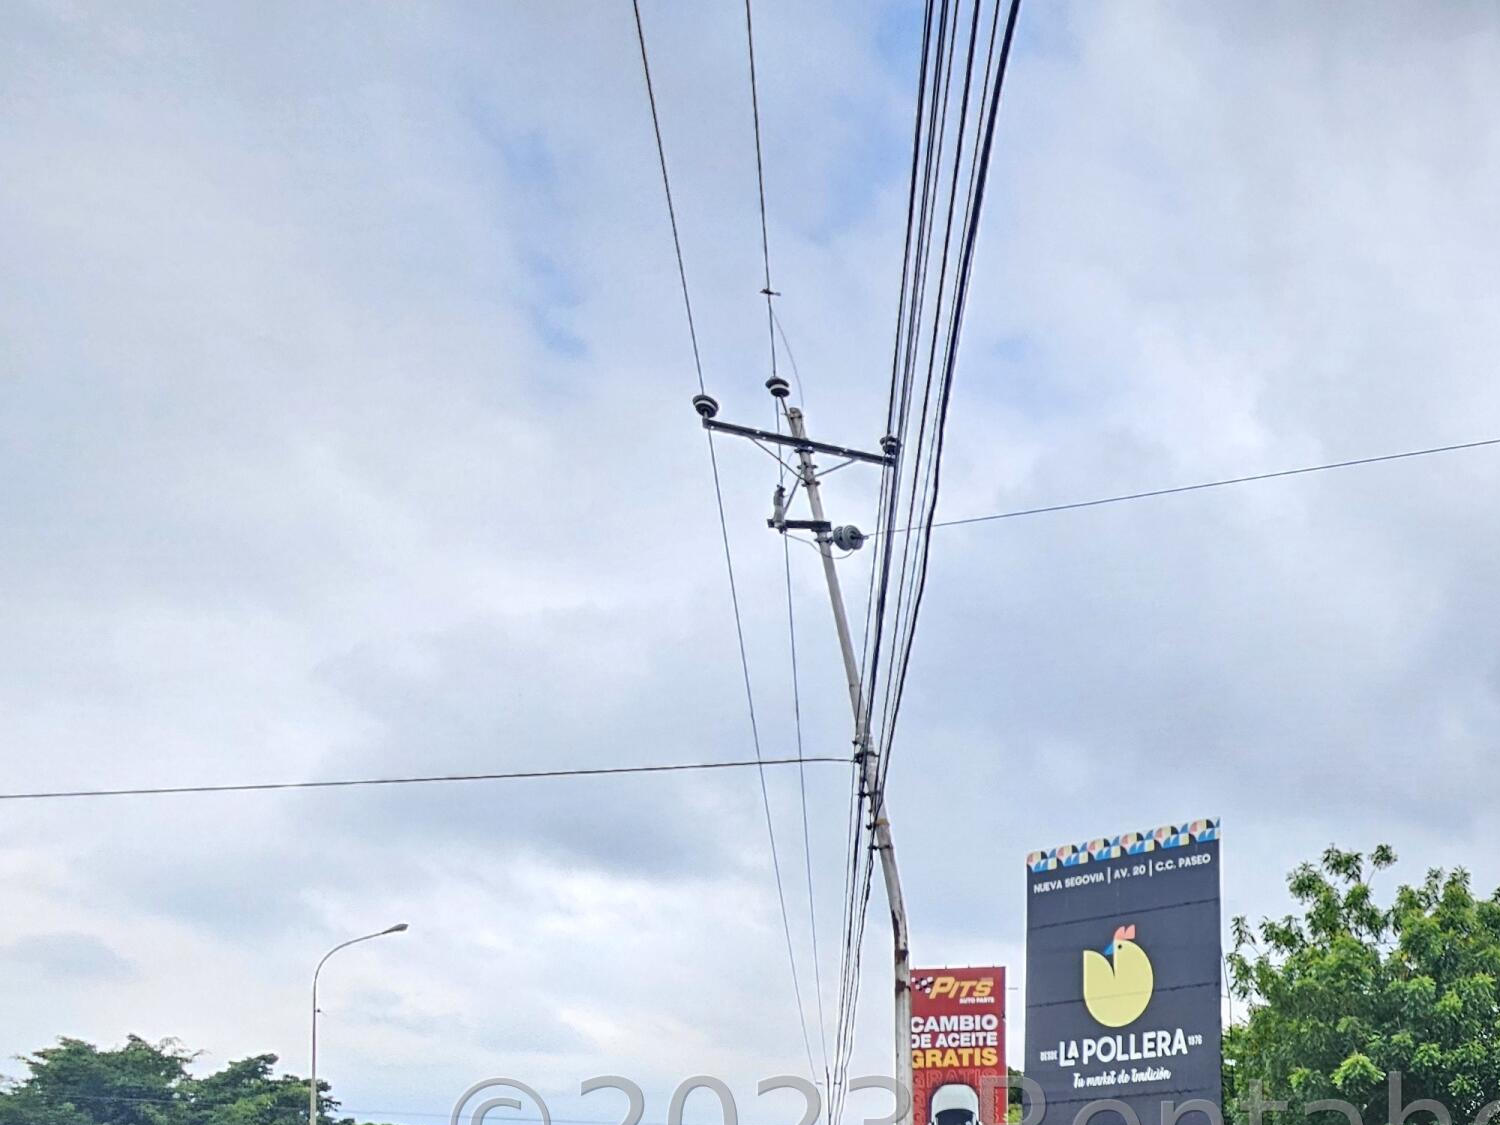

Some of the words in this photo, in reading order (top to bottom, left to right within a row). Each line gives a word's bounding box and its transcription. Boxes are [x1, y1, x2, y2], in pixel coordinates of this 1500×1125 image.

[1113, 867, 1131, 880] AV.
[1132, 864, 1146, 876] 20
[1155, 859, 1177, 872] C.C.
[1178, 853, 1211, 868] PASEO
[1033, 879, 1063, 894] NUEVA
[1065, 872, 1105, 888] SEGOVIA
[929, 976, 994, 999] PITS
[911, 1013, 999, 1033] CAMBIO
[911, 1033, 932, 1049] DE
[935, 1031, 998, 1048] ACEITE
[1059, 1040, 1079, 1067] LA
[1082, 1028, 1188, 1065] POLLERA
[911, 1048, 998, 1069] GRATIS
[1073, 1072, 1085, 1089] Tu
[1086, 1070, 1116, 1087] market
[1117, 1068, 1130, 1084] de
